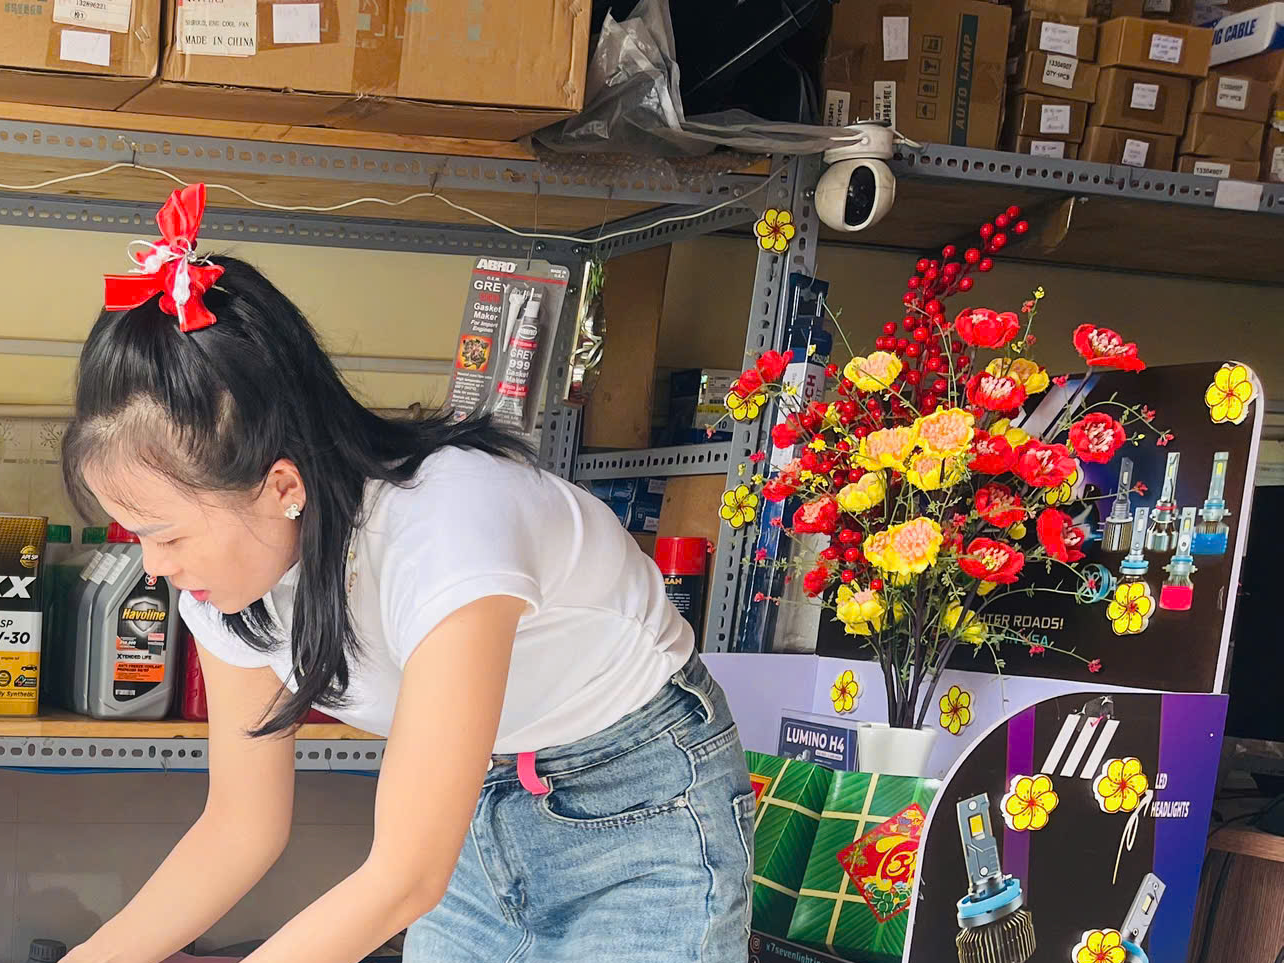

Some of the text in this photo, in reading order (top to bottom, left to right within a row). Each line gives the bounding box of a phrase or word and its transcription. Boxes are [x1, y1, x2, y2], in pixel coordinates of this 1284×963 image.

[1224, 19, 1258, 43] CABLE
[185, 35, 254, 47] MADE IN CHINA
[955, 33, 974, 130] AUTO LAMP
[476, 258, 517, 273] ABRO
[473, 280, 510, 293] GREY
[473, 302, 502, 313] Gasket
[473, 311, 498, 321] Maker
[510, 348, 534, 361] GREY
[508, 360, 531, 371] 999
[122, 608, 166, 621] Havoline
[0, 619, 13, 628] SP
[1013, 615, 1064, 631] ROADS!
[7, 690, 35, 698] Synthetic
[786, 727, 845, 753] LUMINO H4
[1155, 773, 1168, 790] LED
[1150, 801, 1191, 818] HEADLIGHTS
